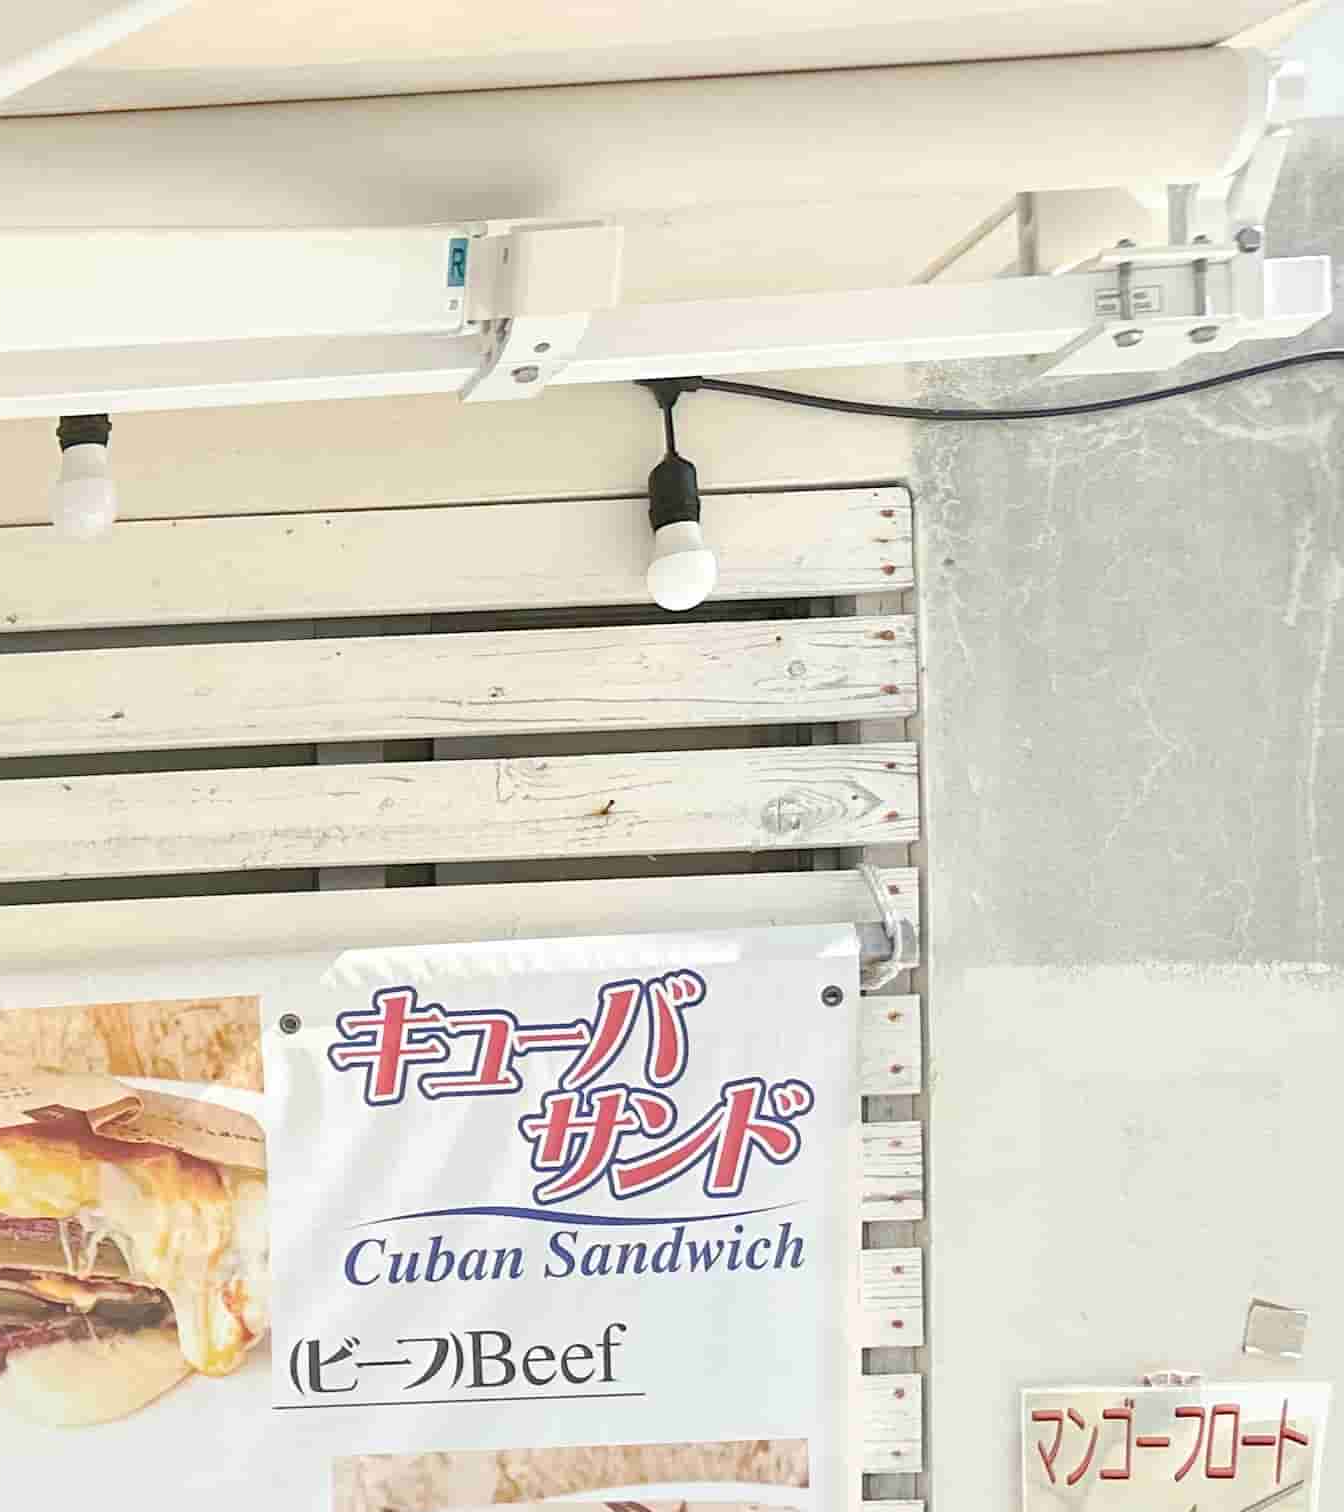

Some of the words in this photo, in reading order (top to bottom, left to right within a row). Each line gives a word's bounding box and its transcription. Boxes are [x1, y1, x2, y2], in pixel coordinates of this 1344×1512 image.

[327, 968, 706, 1105] キューバ
[519, 1077, 814, 1204] サンド
[344, 1235, 524, 1285] Cuban
[544, 1223, 806, 1280] Sandwich
[1031, 1397, 1310, 1486] マンゴーフロート
